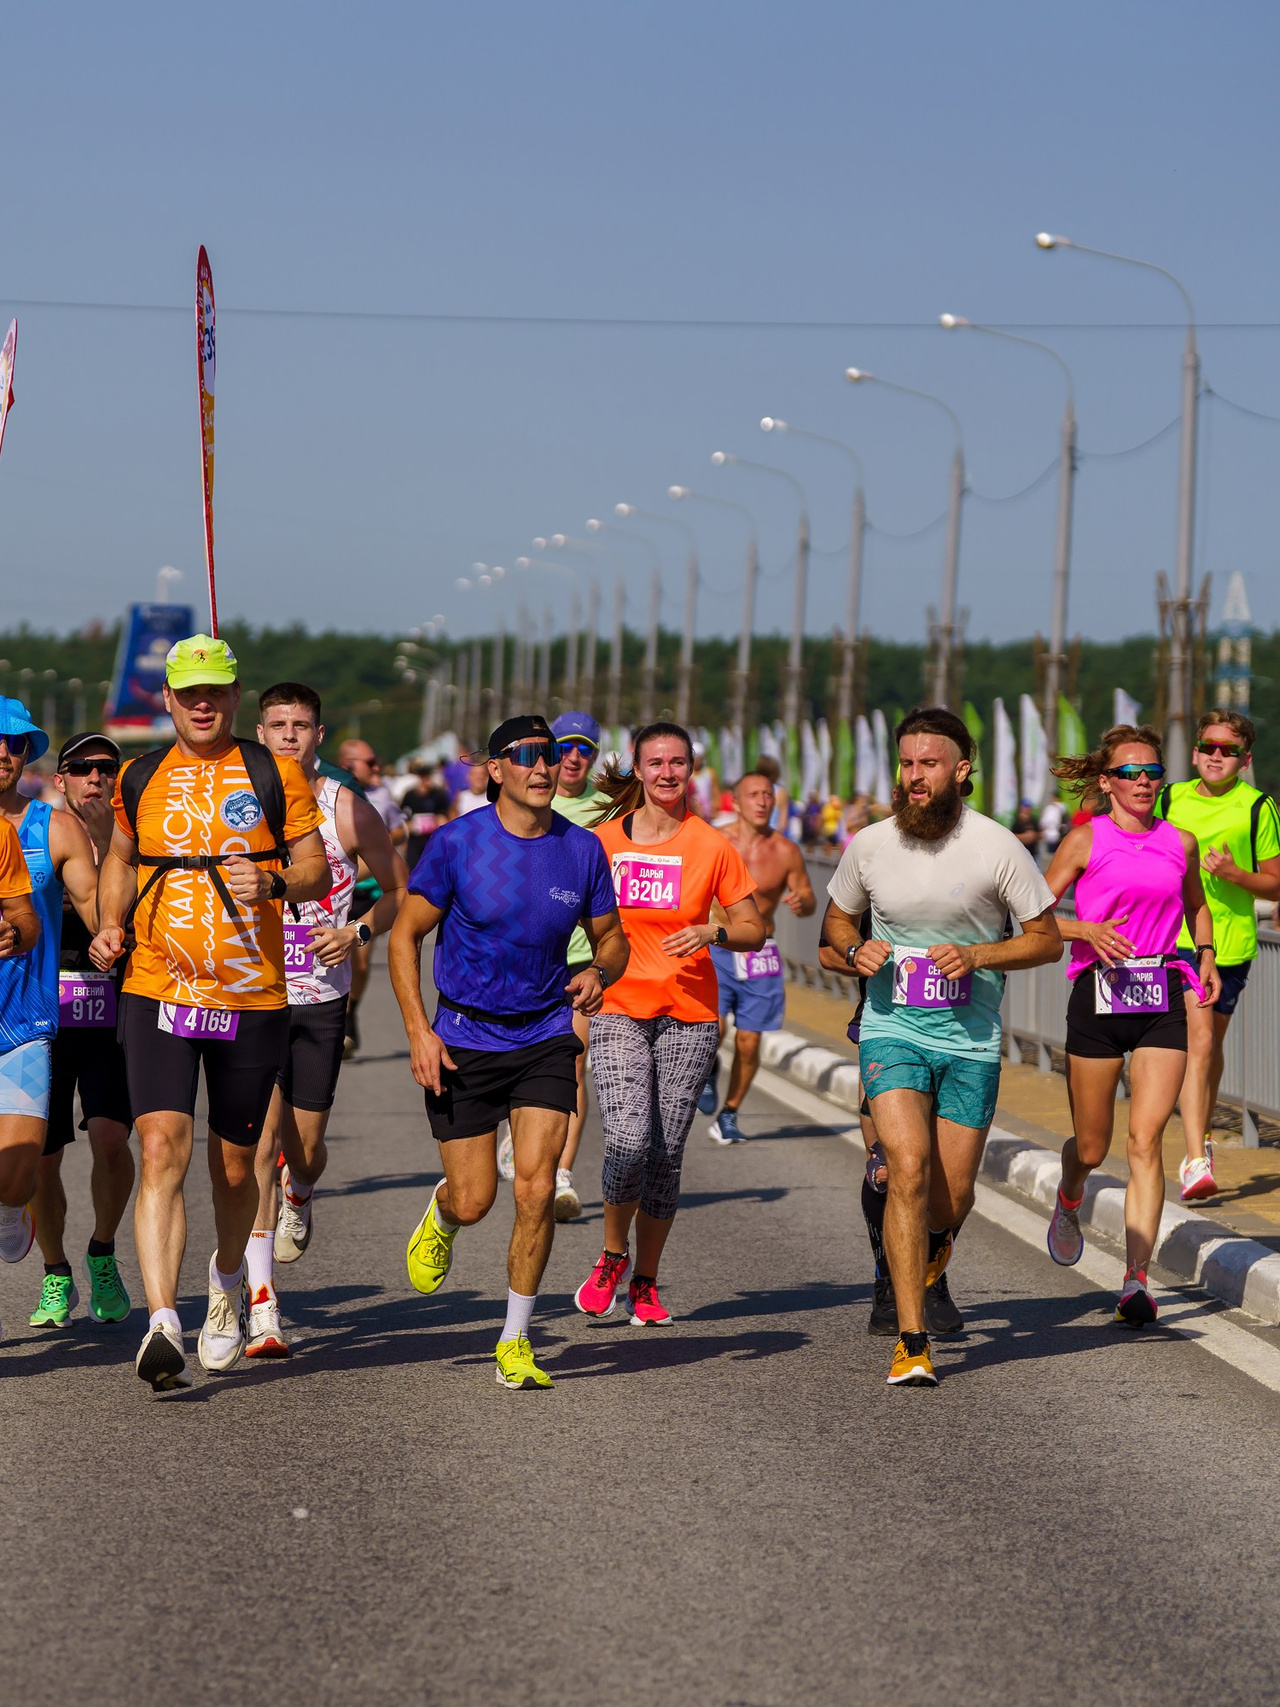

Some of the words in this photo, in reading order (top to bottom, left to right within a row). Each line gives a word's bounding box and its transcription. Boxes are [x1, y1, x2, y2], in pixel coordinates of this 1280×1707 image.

[639, 868, 664, 879] ДАРЬЯ
[629, 879, 673, 903] 3204
[1130, 972, 1154, 982] МАРИЯ
[73, 985, 105, 997] ЕВГЕНИЙ
[1121, 984, 1163, 1006] 4849
[72, 998, 105, 1021] 912
[184, 1007, 232, 1033] 4169
